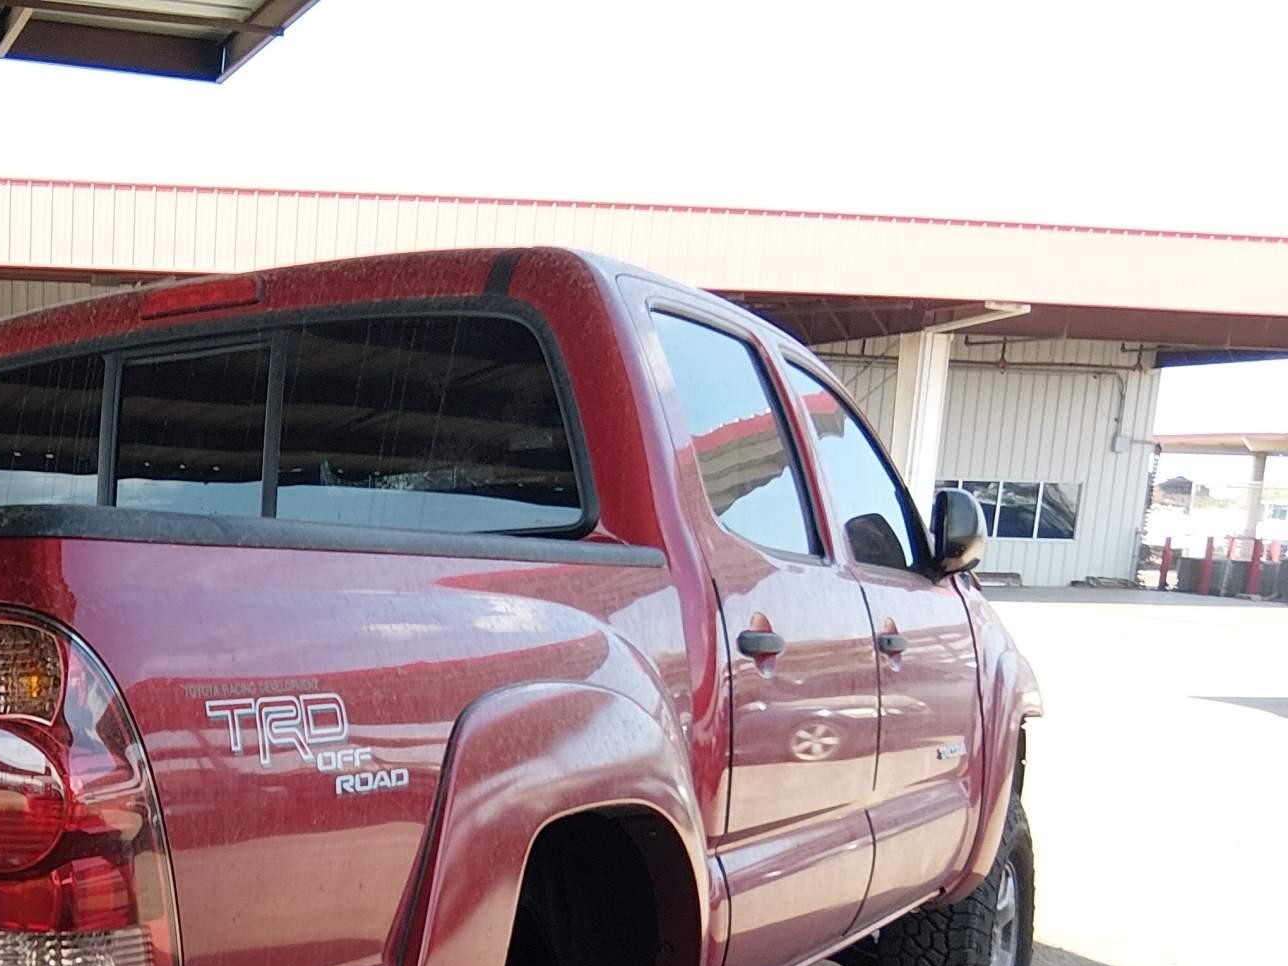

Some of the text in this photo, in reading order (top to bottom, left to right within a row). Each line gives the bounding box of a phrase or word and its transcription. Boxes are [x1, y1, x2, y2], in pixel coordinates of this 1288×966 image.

[205, 692, 350, 767] TRD
[316, 747, 373, 772] OFF
[335, 767, 410, 795] ROAD
